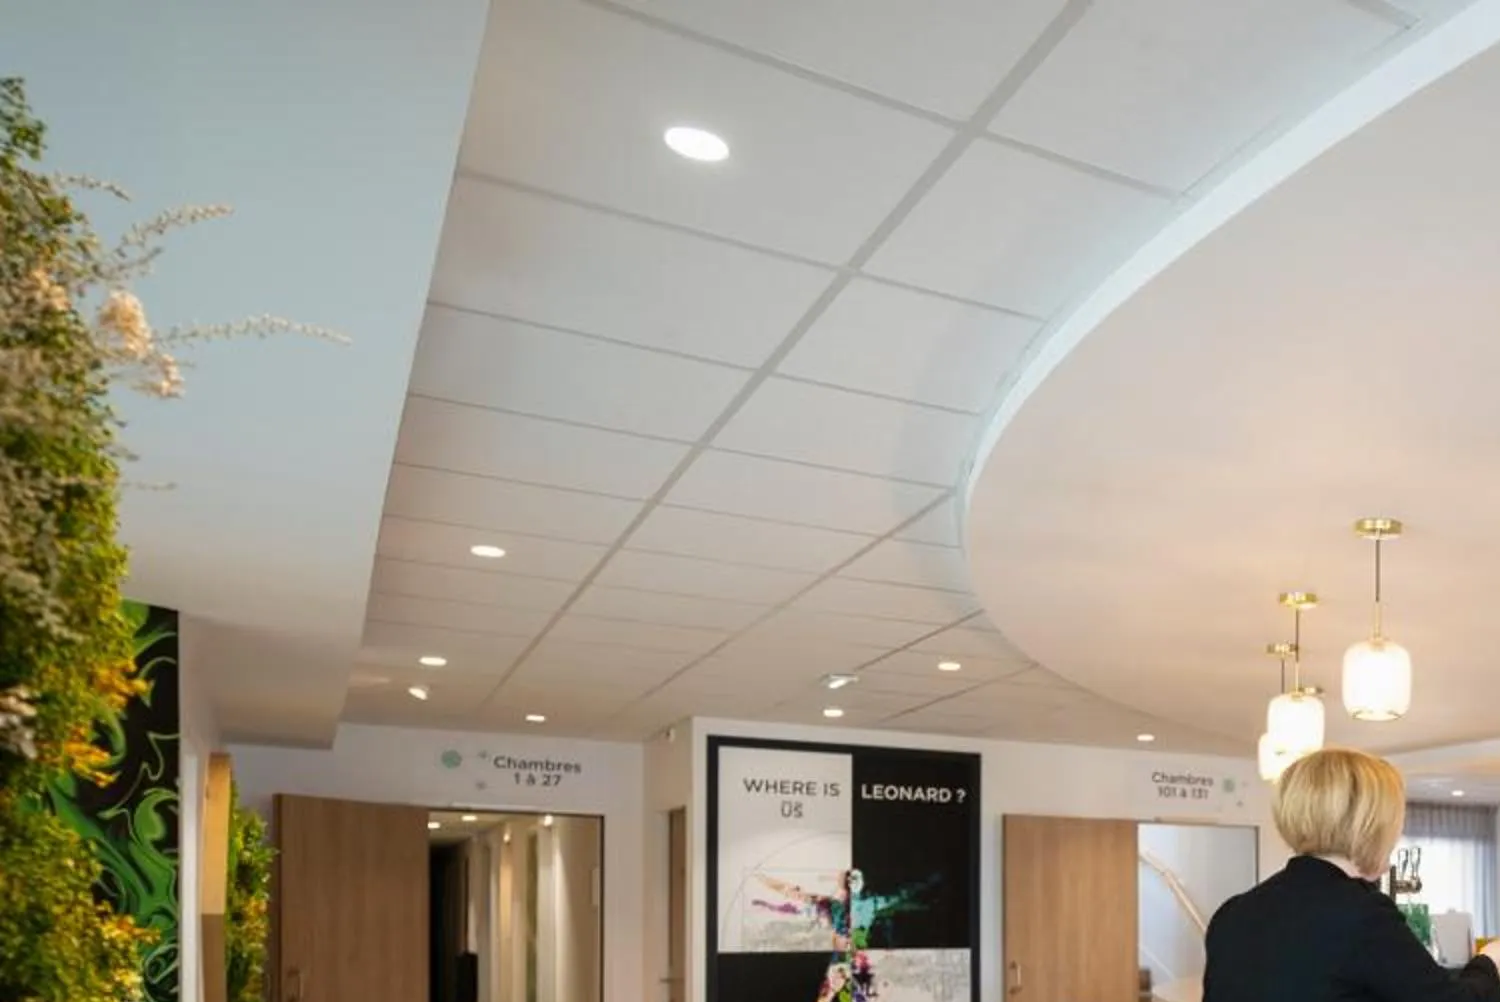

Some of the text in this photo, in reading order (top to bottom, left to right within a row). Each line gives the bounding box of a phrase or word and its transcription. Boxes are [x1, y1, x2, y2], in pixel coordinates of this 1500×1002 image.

[493, 755, 582, 773] Chambres
[541, 774, 561, 786] 27
[743, 778, 966, 803] WHERE IS LEONARD ?
